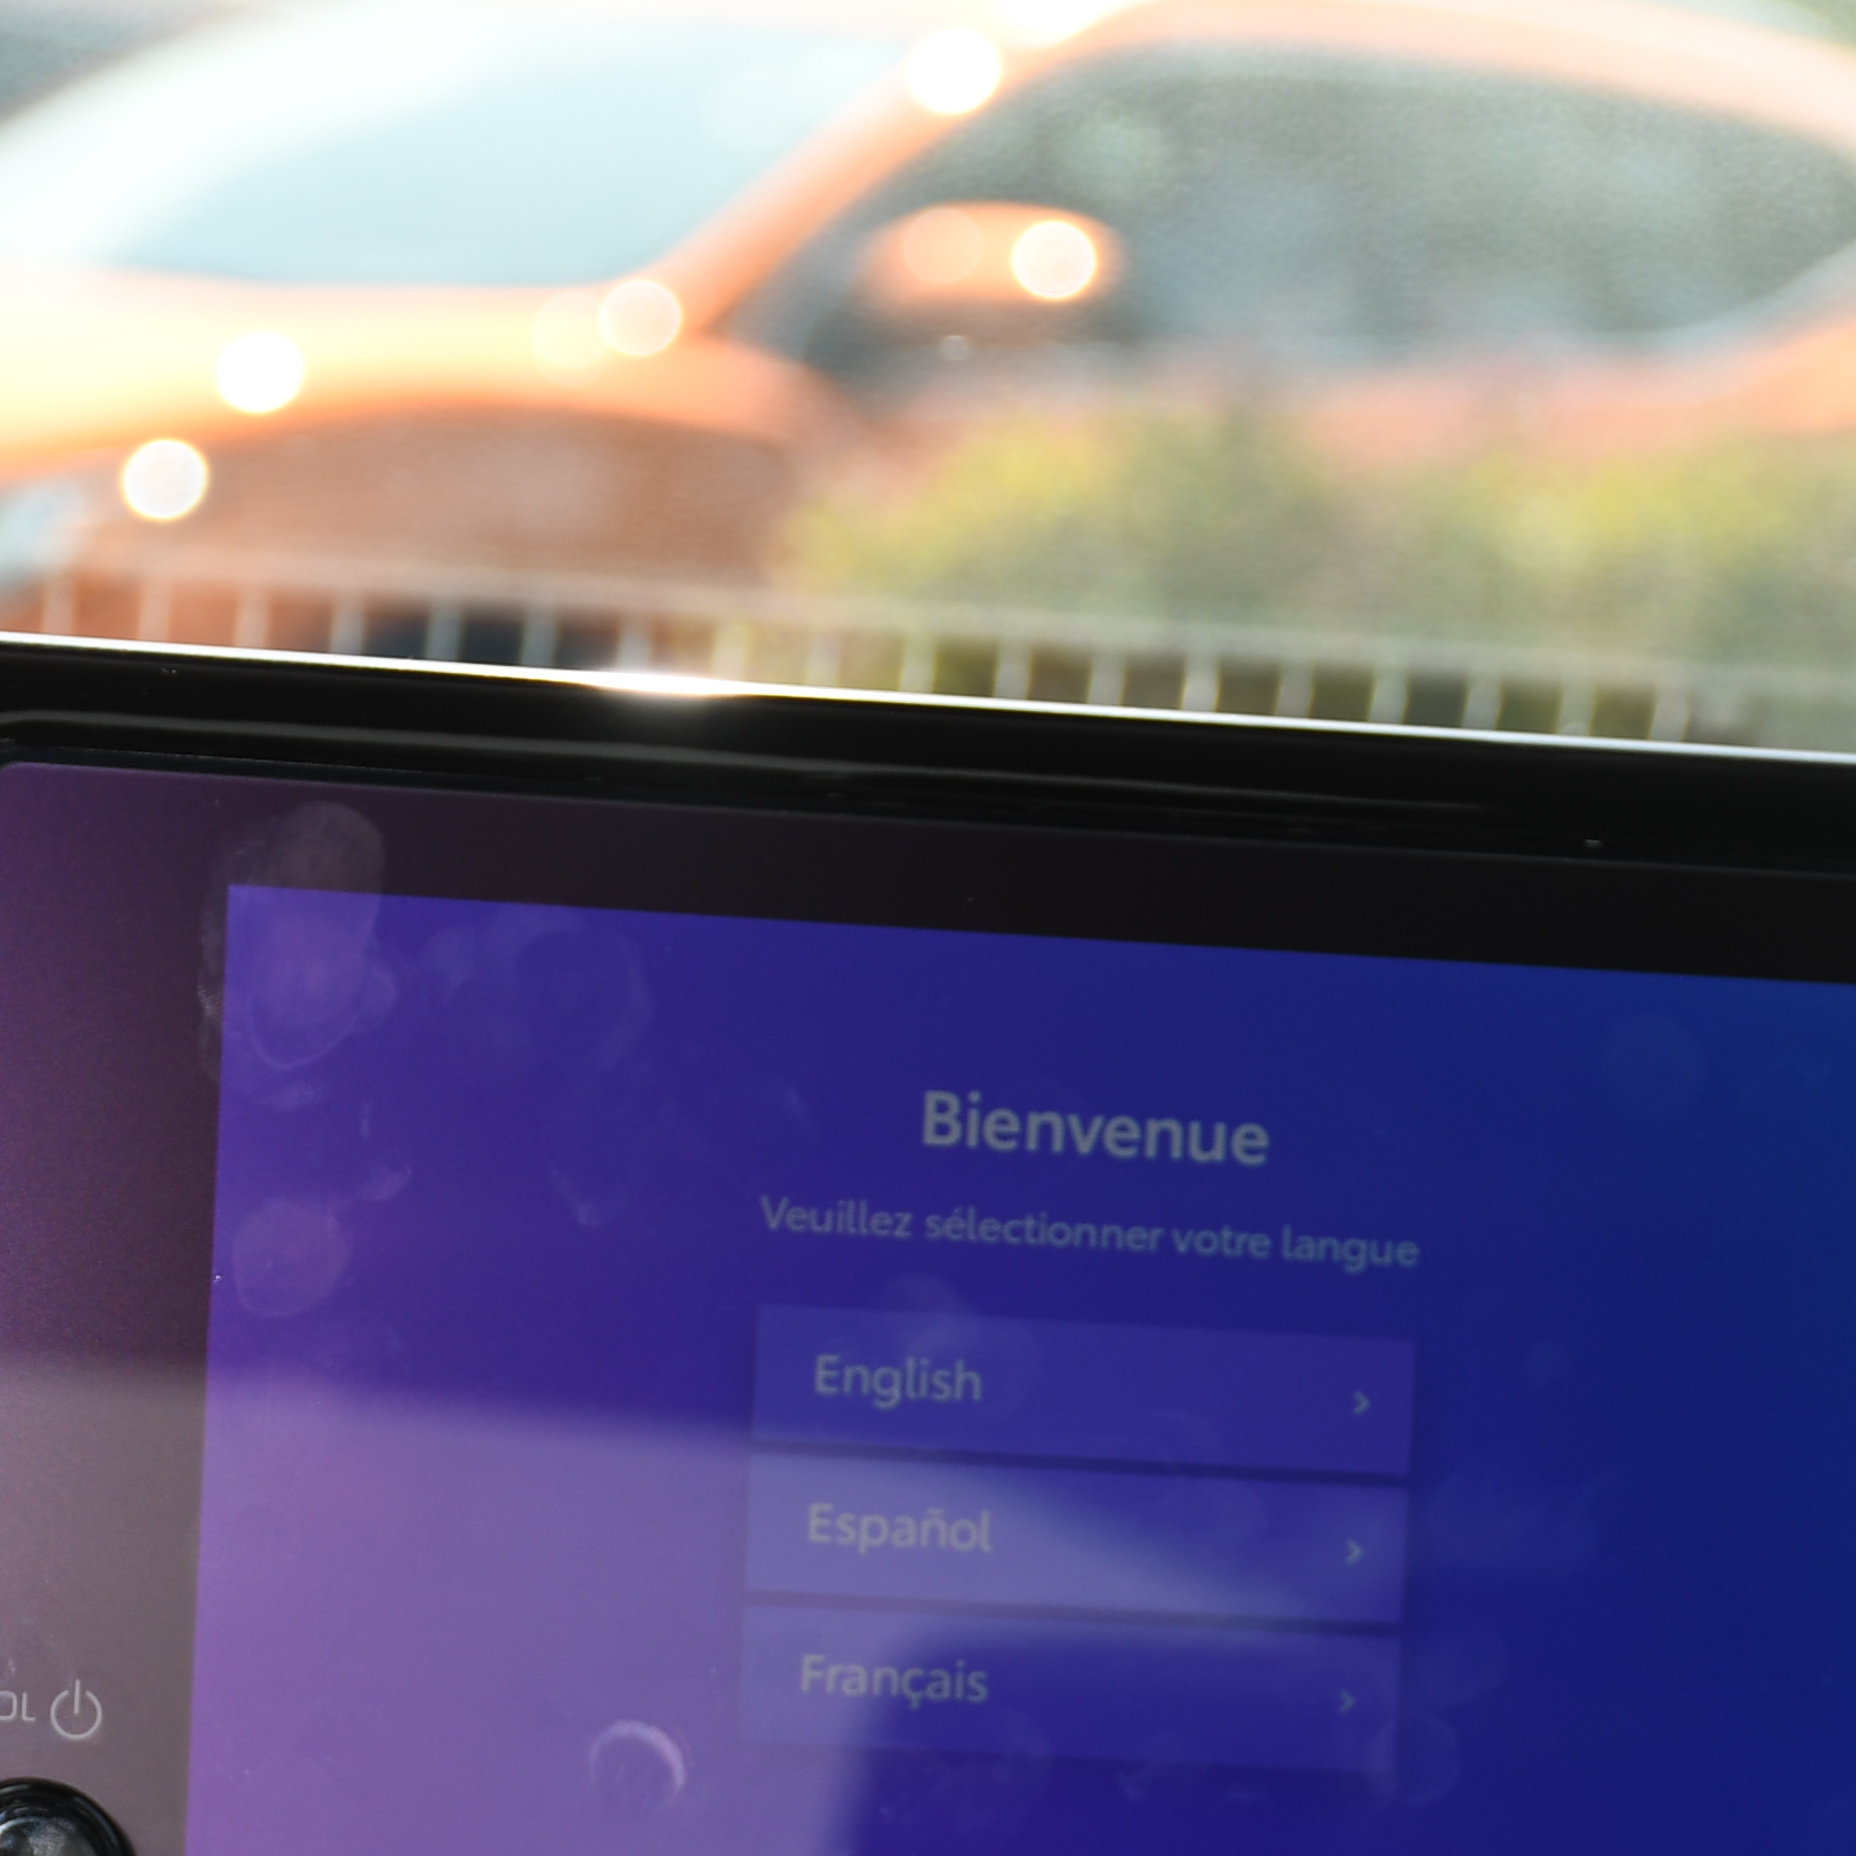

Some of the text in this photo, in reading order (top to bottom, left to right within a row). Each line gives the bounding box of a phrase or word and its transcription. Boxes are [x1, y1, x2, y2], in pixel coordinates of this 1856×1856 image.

[922, 1090, 1270, 1165] Bienvenue
[760, 1197, 1420, 1273] Veuillez sélectionner votre langue
[814, 1353, 985, 1409] English
[805, 1500, 994, 1555] Español
[798, 1652, 990, 1710] Français
